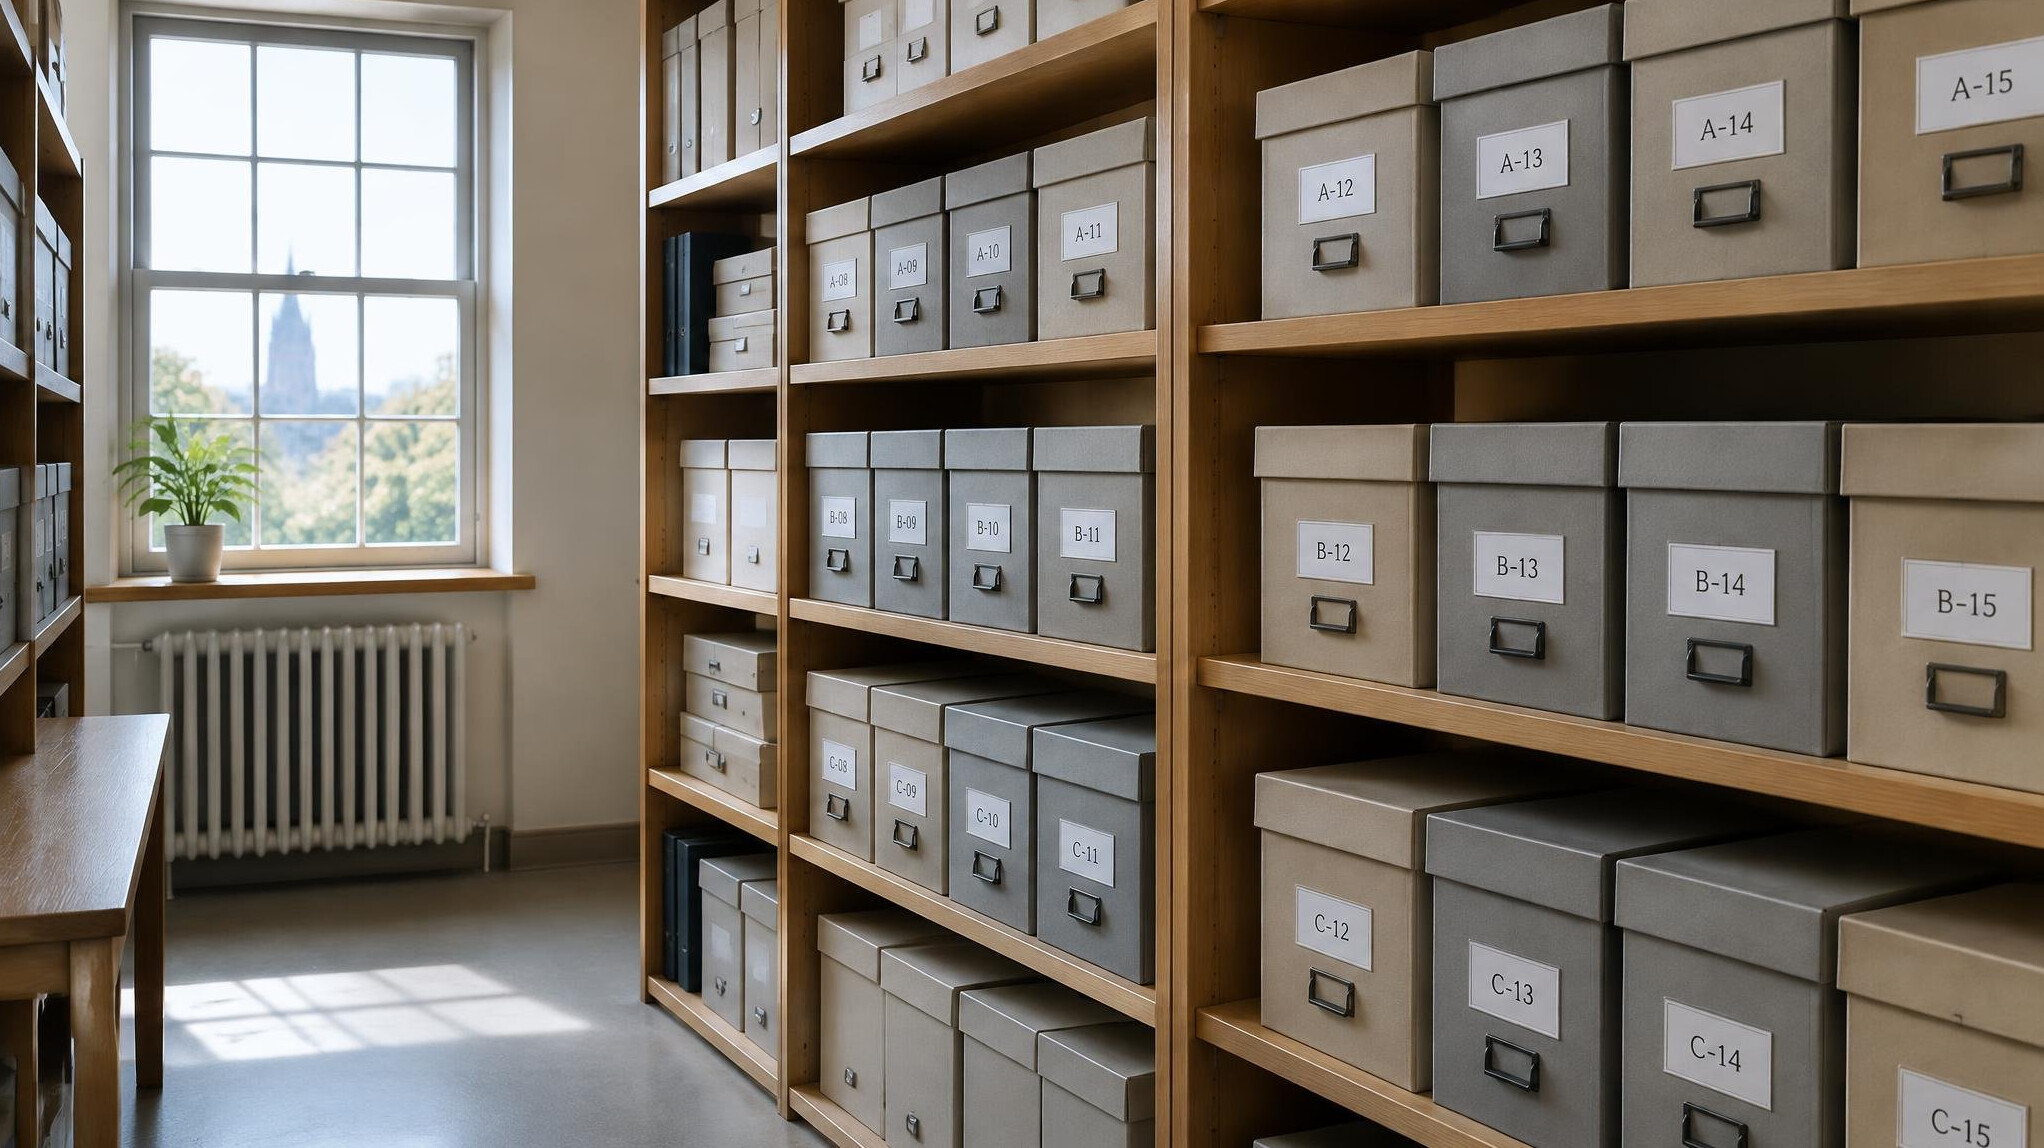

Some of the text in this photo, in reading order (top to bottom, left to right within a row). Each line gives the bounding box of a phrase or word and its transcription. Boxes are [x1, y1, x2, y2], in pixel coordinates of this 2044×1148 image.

[1950, 68, 2013, 102] A-15
[1700, 111, 1754, 141] A-14
[1499, 147, 1543, 174] A-13
[1317, 178, 1354, 202] A-12
[1074, 219, 1102, 243] A-11
[976, 243, 1000, 262] A-10
[897, 258, 918, 276] A-09
[829, 272, 849, 289] A-08
[830, 510, 848, 525] B-08
[896, 514, 917, 530] B-09
[977, 519, 999, 536] B-10
[1075, 525, 1100, 543] B-11
[1317, 541, 1351, 562] B-12
[1496, 555, 1538, 579] B-13
[1695, 569, 1746, 596] B-14
[1937, 588, 1997, 618] B-15
[896, 779, 917, 799] C-09
[976, 807, 999, 829] C-10
[1072, 841, 1099, 865] C-11
[1314, 913, 1350, 942] C-12
[1491, 973, 1534, 1006] C-13
[1690, 1035, 1742, 1073] C-14
[1931, 1108, 1991, 1148] C-15
